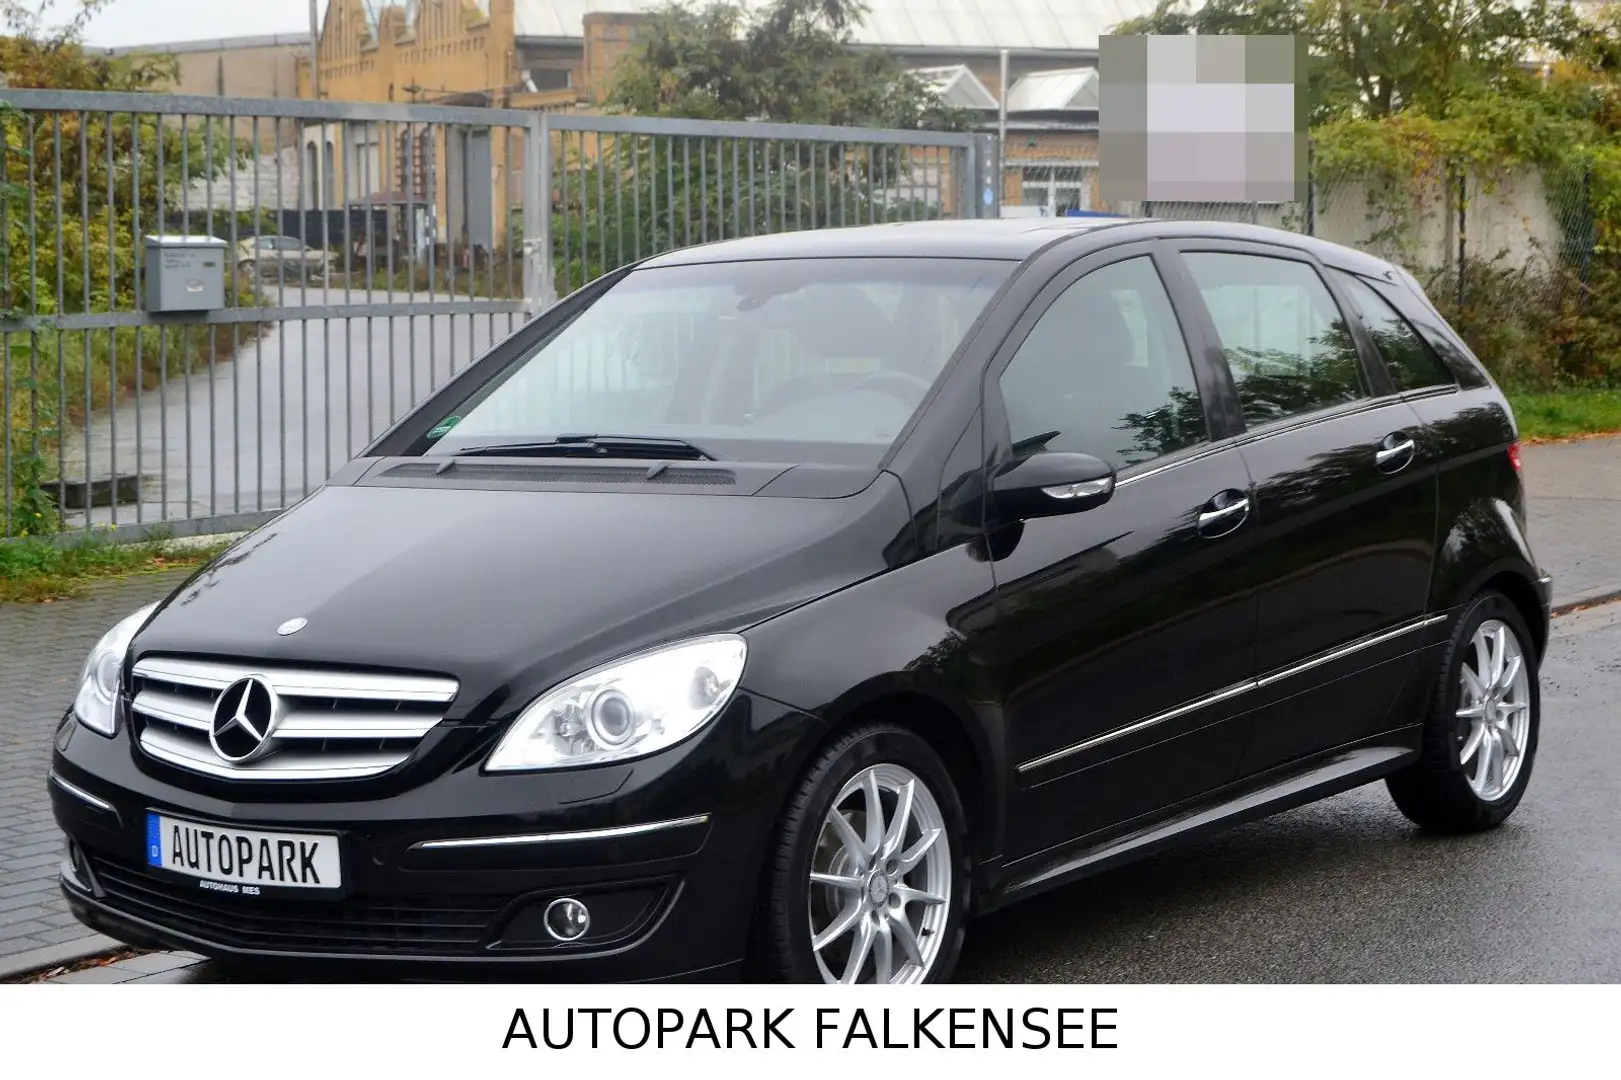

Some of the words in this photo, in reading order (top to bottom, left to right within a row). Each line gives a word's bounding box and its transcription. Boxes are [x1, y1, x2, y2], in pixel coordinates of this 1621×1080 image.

[151, 845, 159, 858] D
[172, 825, 320, 884] AUTOPARK
[199, 880, 240, 893] AUTOHAUS
